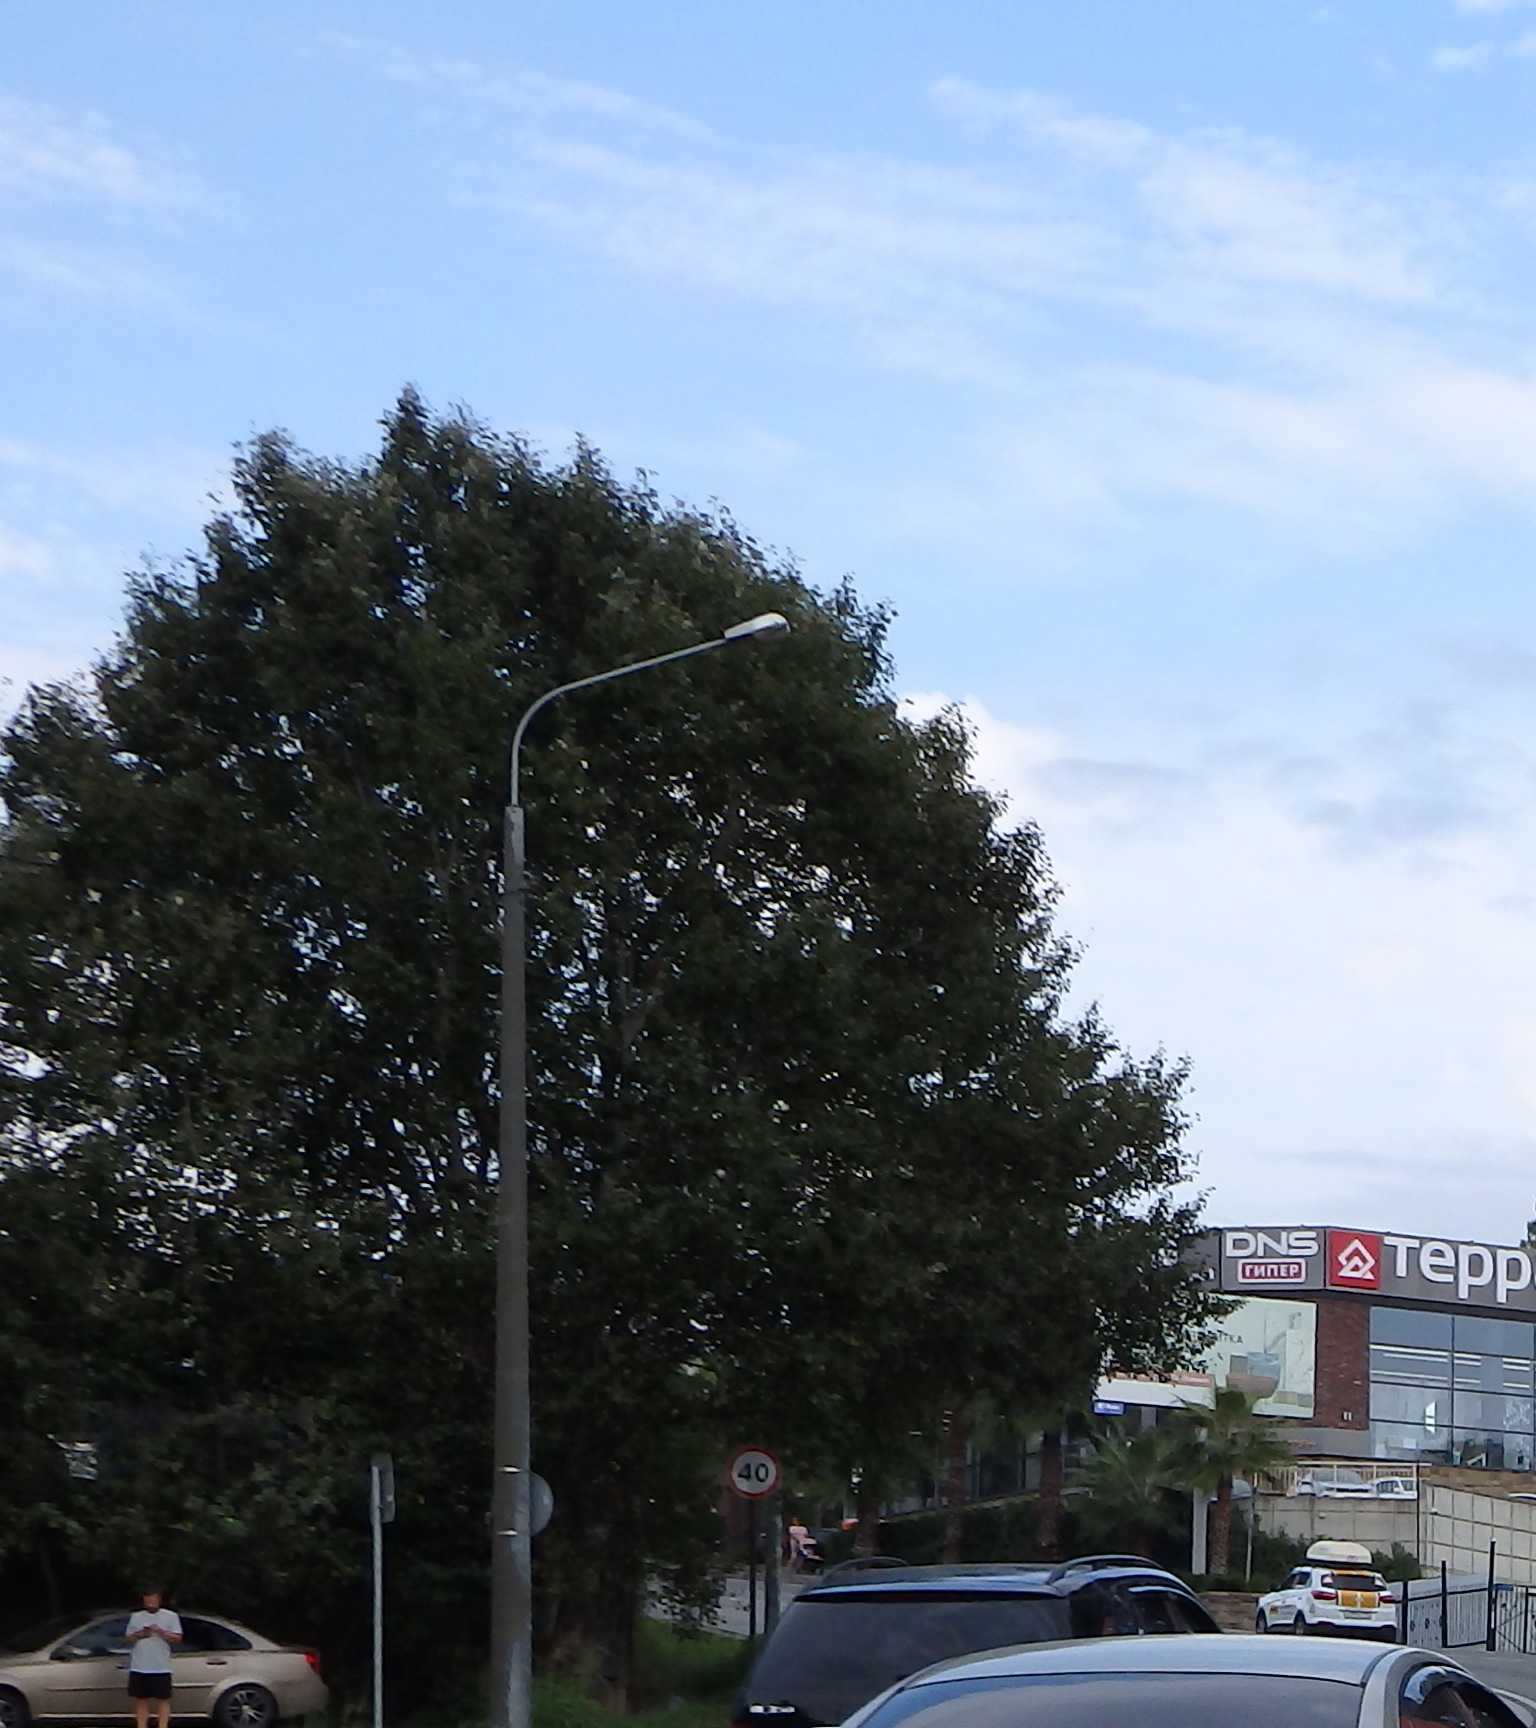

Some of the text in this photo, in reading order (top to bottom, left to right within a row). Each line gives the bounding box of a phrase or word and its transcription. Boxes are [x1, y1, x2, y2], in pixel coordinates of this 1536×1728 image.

[1225, 1231, 1319, 1257] DNS
[1244, 1263, 1301, 1279] ГИПЕР
[737, 1462, 769, 1483] 40
